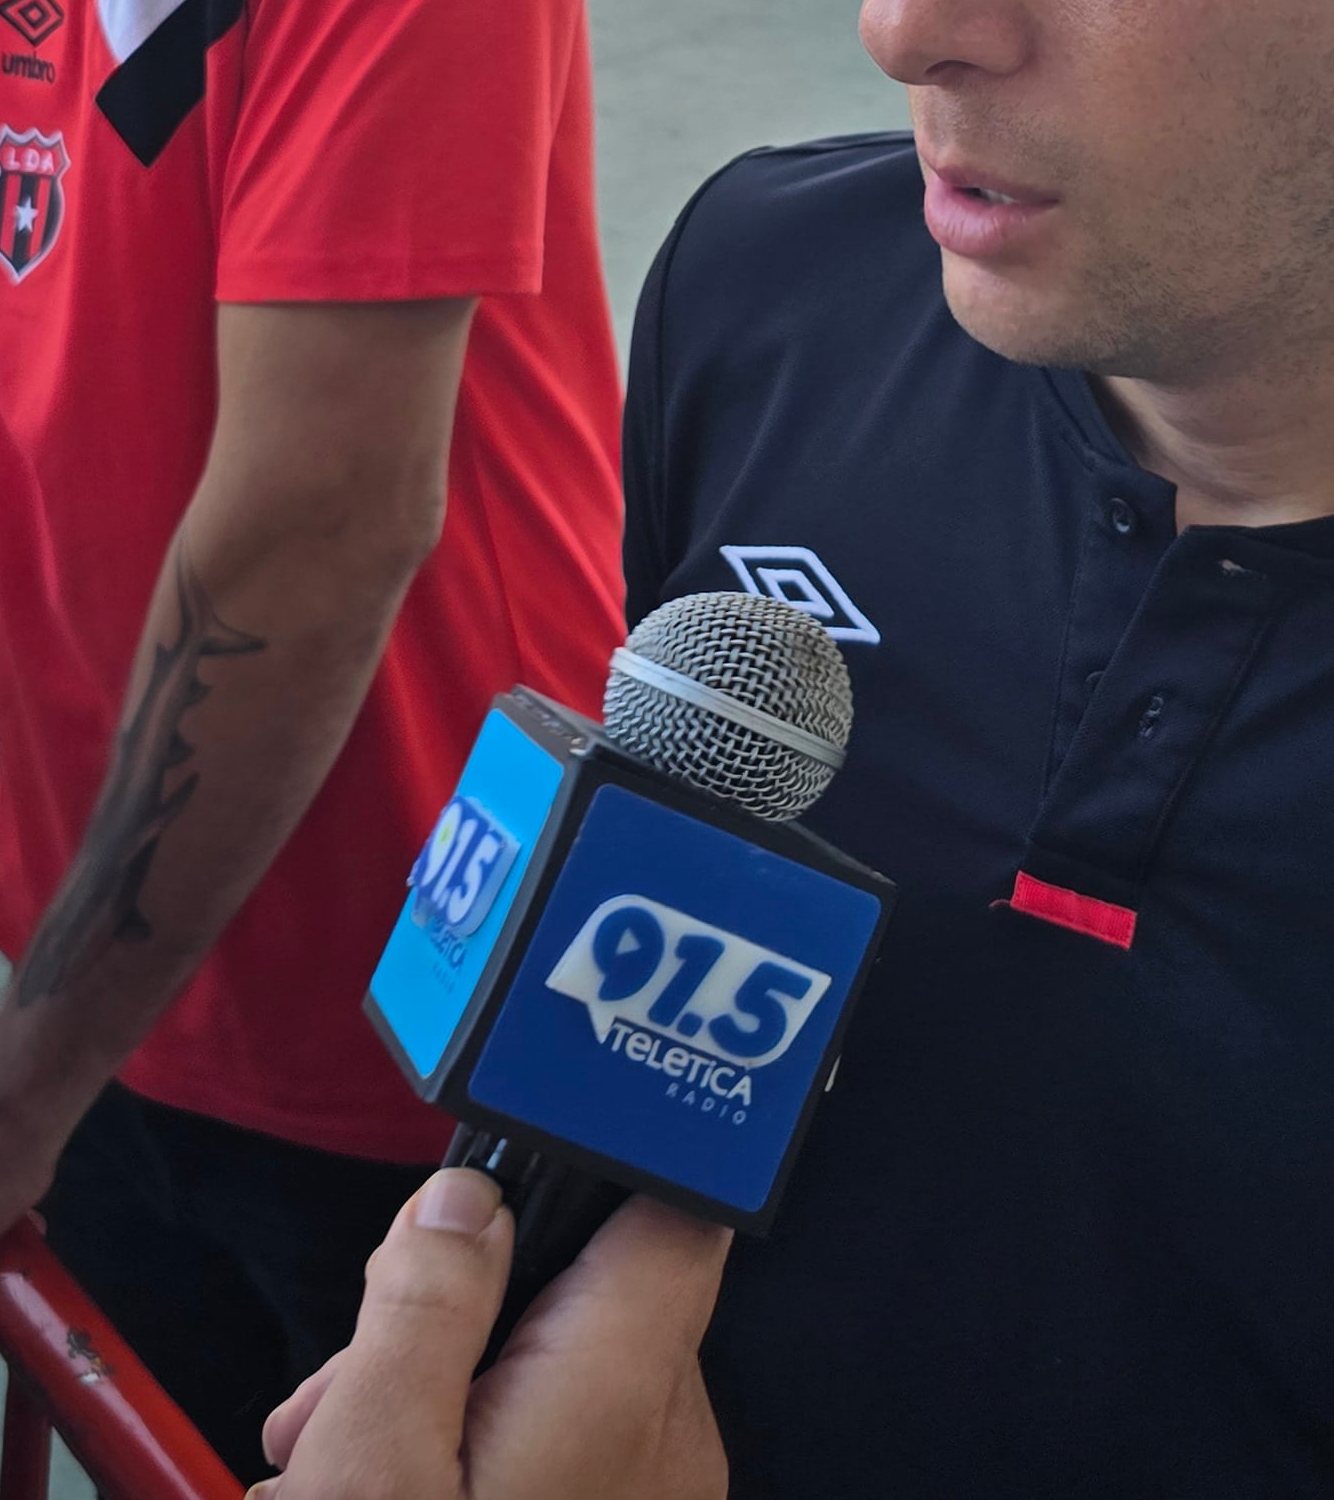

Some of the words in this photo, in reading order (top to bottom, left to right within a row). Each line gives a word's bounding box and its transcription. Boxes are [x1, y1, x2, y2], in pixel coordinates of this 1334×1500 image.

[1, 50, 57, 84] umbro
[5, 145, 55, 175] LDA
[592, 906, 814, 1058] 91.5
[665, 1082, 748, 1126] RADIO
